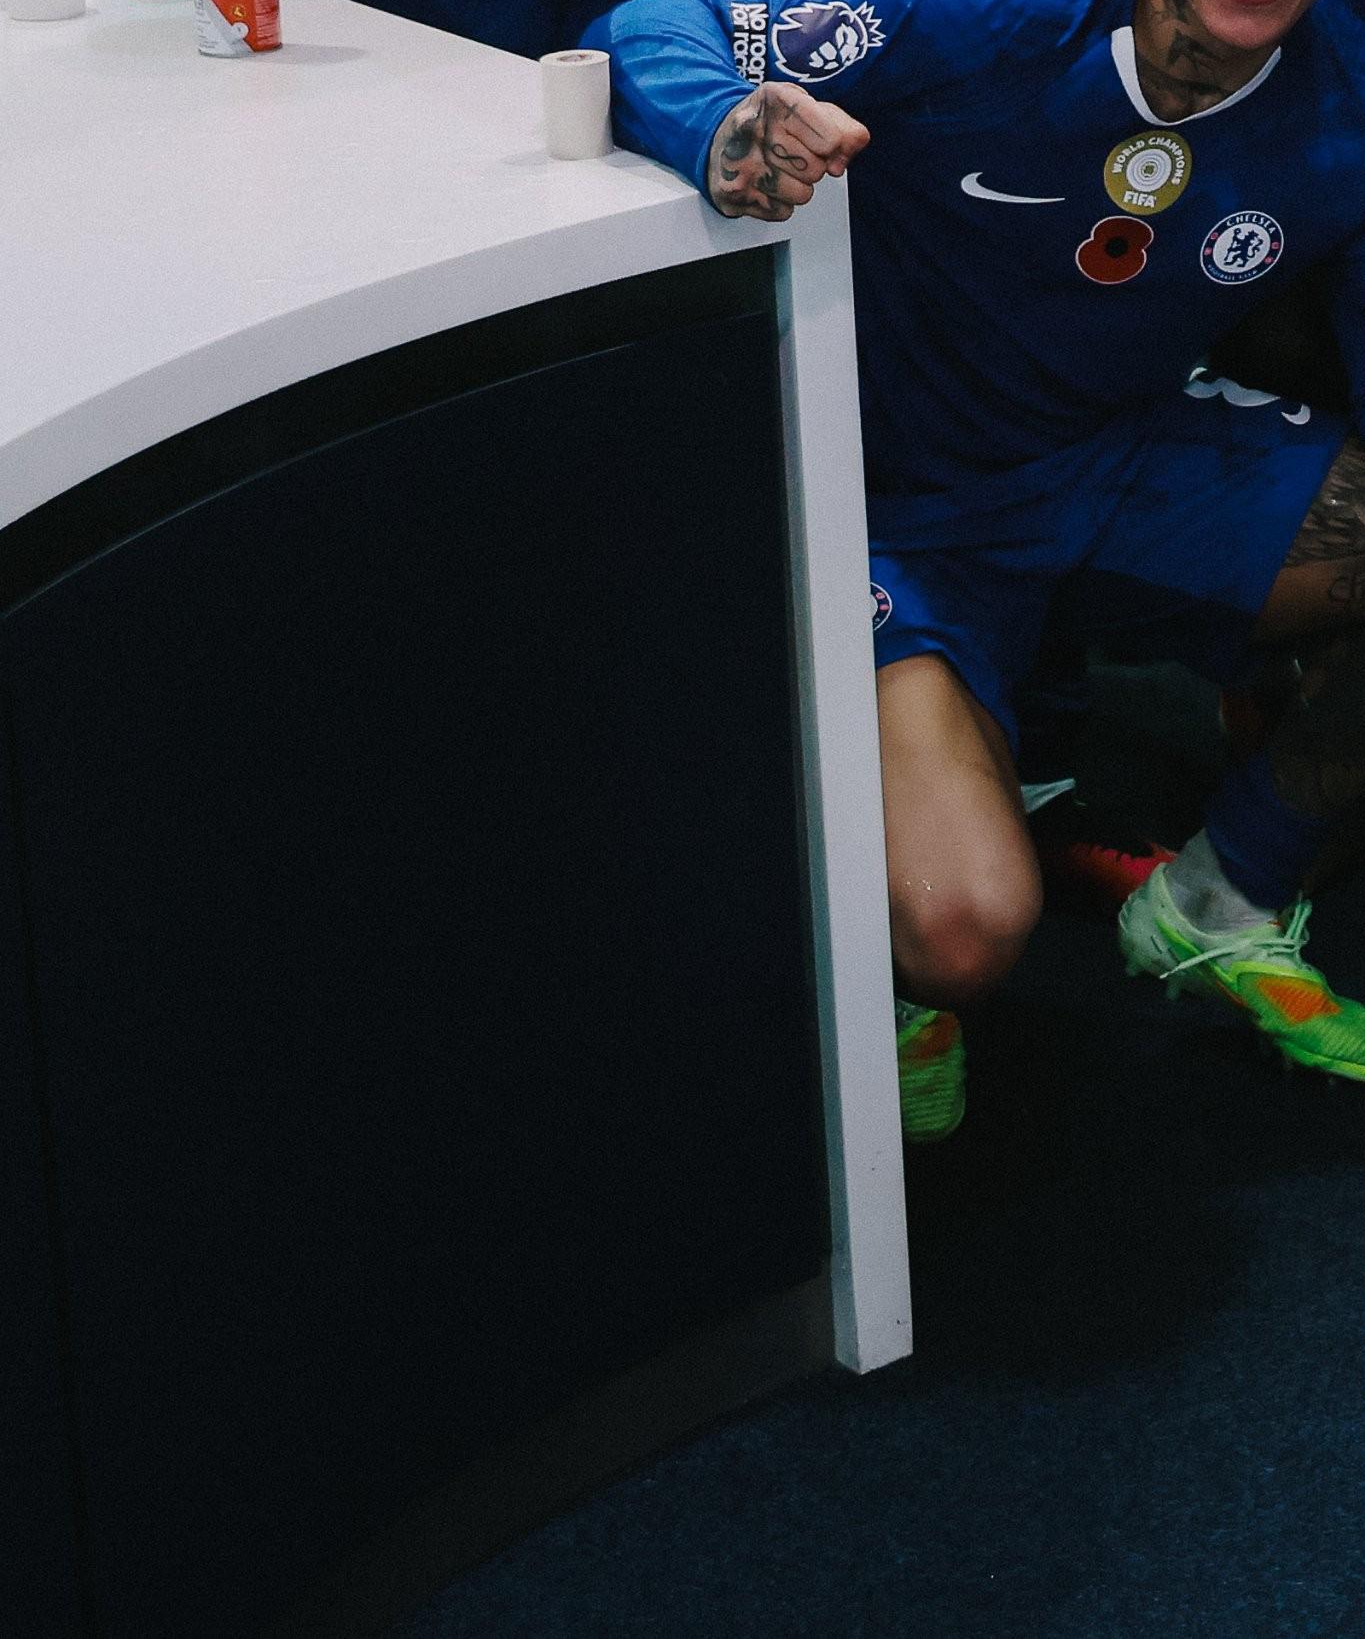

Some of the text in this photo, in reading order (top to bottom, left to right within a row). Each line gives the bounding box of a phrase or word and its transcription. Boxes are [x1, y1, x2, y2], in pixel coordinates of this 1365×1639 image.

[749, 3, 769, 31] No
[1112, 136, 1186, 186] WORLD CHAMPIONS
[1123, 190, 1157, 209] FIFA
[1226, 213, 1277, 235] CHELSEA
